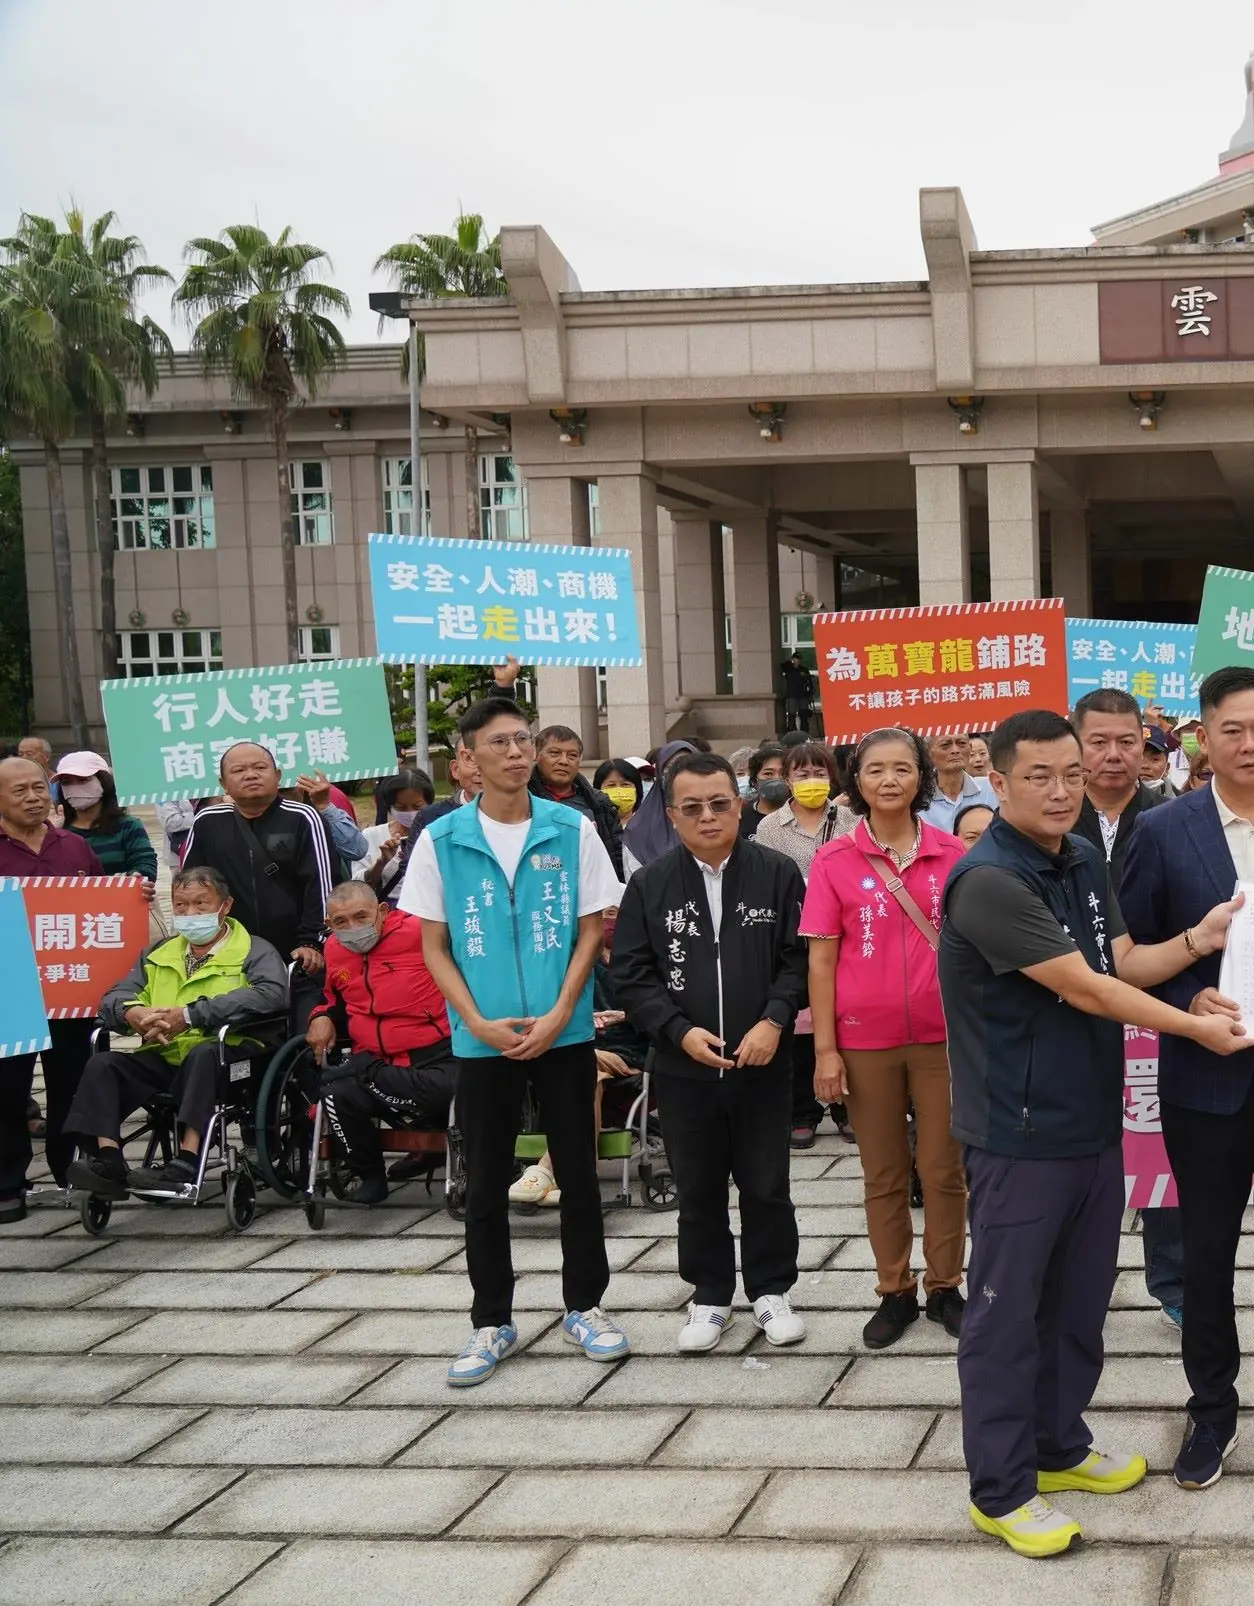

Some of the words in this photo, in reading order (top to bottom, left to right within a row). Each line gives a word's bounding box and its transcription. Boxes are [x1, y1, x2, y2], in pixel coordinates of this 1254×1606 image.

[387, 561, 618, 600] 安全、人潮、商機
[393, 602, 616, 644] 一起走出來!
[825, 633, 1048, 683] 為萬寶龍鋪路
[1072, 637, 1196, 666] 安全、人潮、
[153, 679, 343, 733] 行人好走
[848, 680, 1031, 712] 不讓孩子的路充滿風險
[541, 881, 562, 949] 王又民
[685, 901, 700, 936] 代表
[874, 891, 888, 917] 代表
[928, 874, 941, 951] 斗六市民代
[34, 912, 125, 951] 開道
[665, 909, 686, 991] 楊志忠
[1088, 892, 1109, 975] 斗六市公
[37, 963, 91, 983] 爭道
